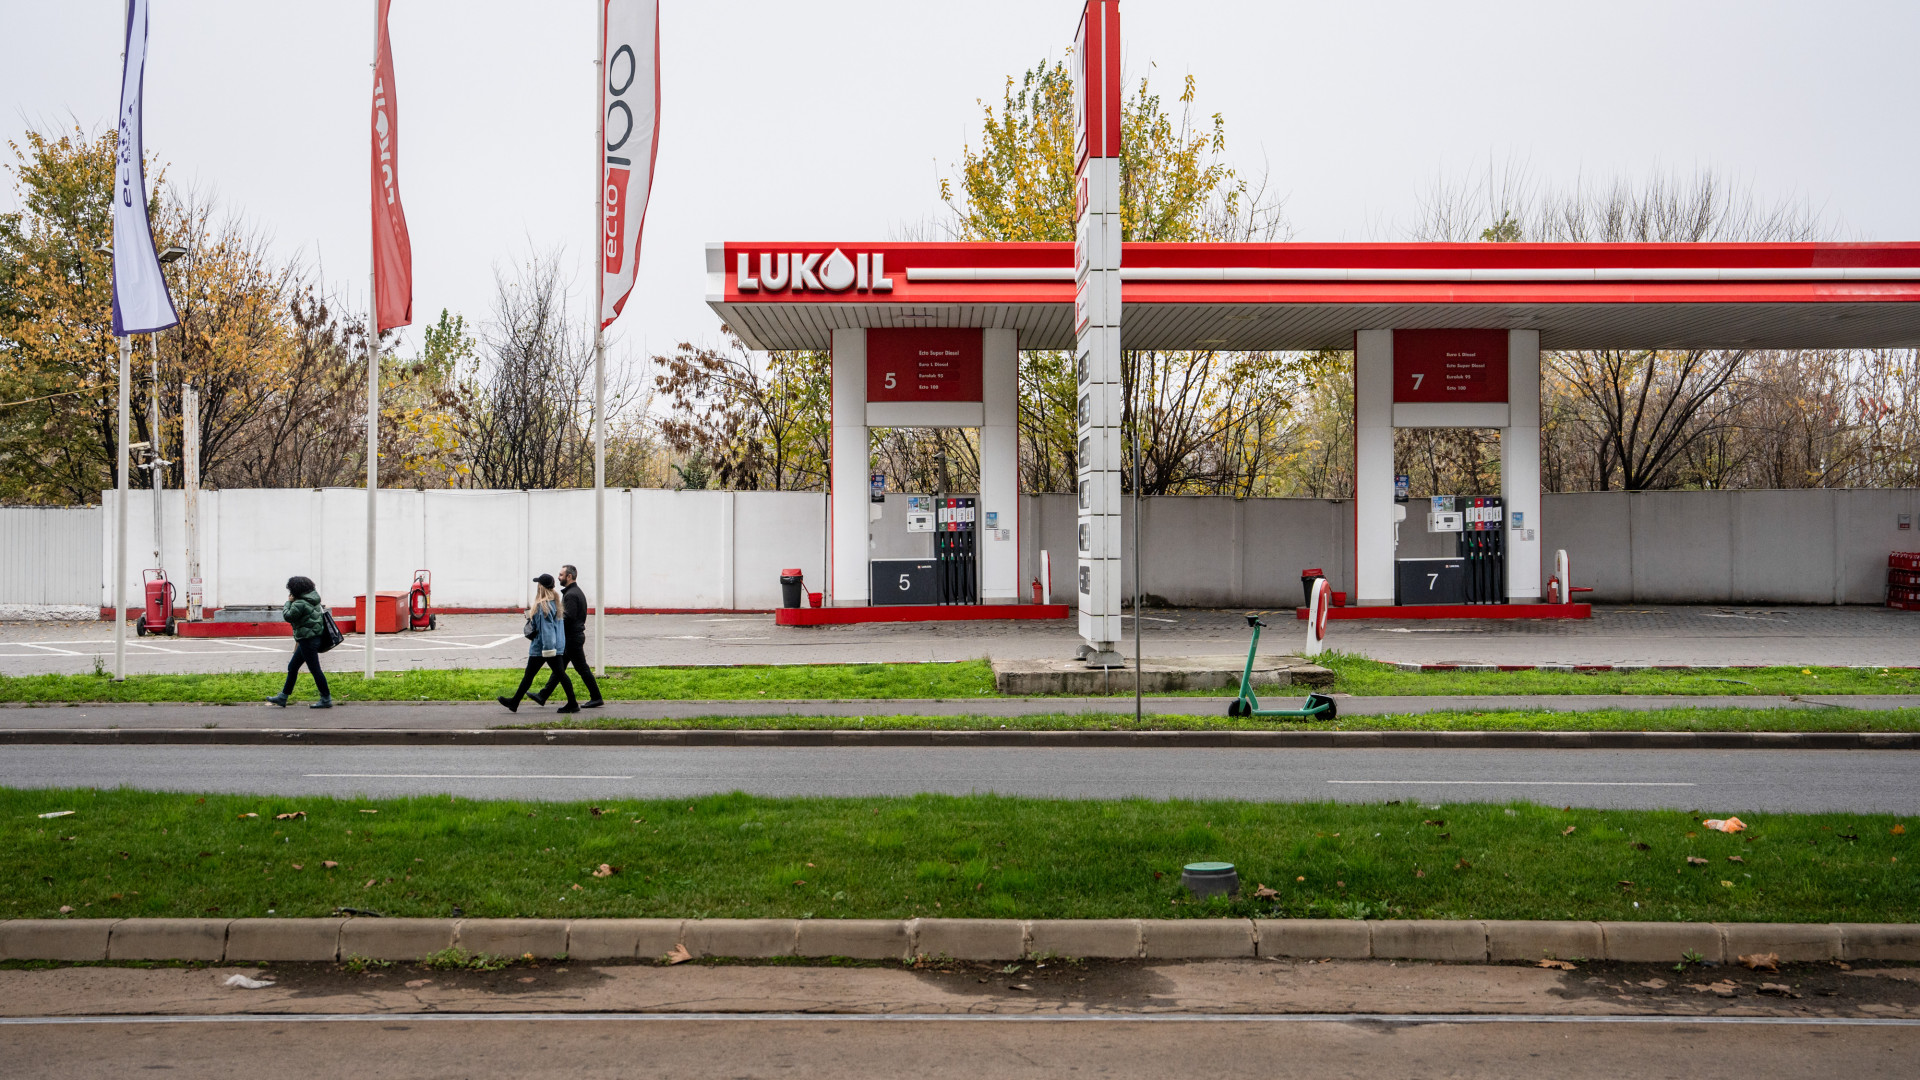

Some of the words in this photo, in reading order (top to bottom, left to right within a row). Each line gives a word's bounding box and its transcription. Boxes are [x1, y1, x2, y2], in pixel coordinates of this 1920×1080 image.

[606, 184, 618, 257] ecto
[737, 247, 893, 291] LUKOIL
[884, 372, 896, 389] 5
[1411, 373, 1424, 390] 7
[899, 574, 911, 591] 5
[1427, 573, 1439, 590] 7
